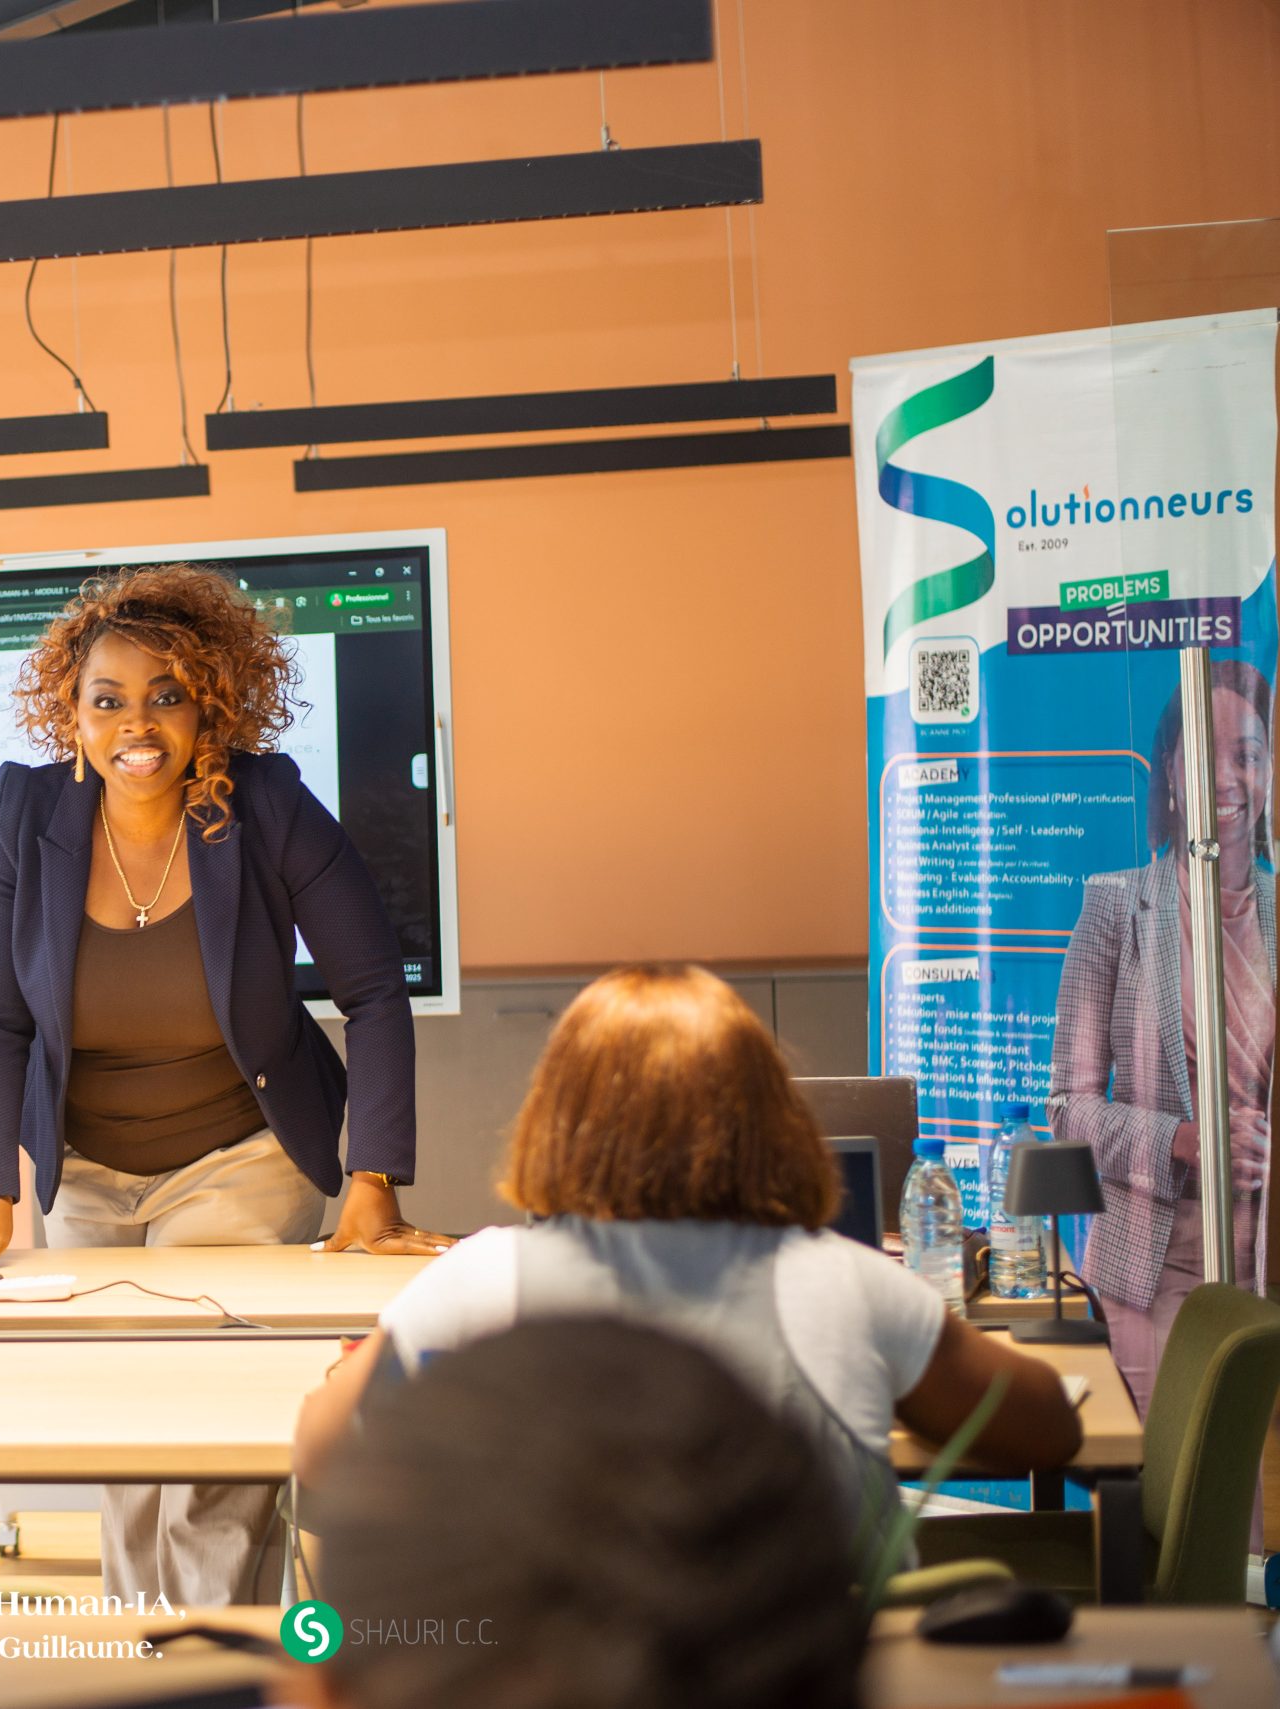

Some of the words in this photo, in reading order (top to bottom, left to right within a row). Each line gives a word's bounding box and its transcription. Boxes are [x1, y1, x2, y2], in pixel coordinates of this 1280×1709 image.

[1018, 540, 1038, 552] Est.
[1041, 538, 1069, 551] 2009
[1066, 577, 1160, 604] PROBLEMS
[1017, 616, 1232, 649] OPPORTUNITIES
[925, 793, 988, 806] Management
[989, 792, 1049, 804] Professional
[1051, 792, 1081, 805] (PMP)
[1083, 793, 1134, 803] certification
[933, 808, 958, 822] Agile
[1002, 824, 1022, 836] Self
[1031, 824, 1085, 838] Leadership
[932, 839, 969, 853] Analyst
[918, 856, 955, 869] Writing
[1002, 872, 1073, 887] Accountability
[932, 888, 969, 902] English
[936, 903, 992, 916] additionnels
[946, 1008, 970, 1019] mise
[1016, 1011, 1029, 1024] de
[921, 1023, 932, 1034] de
[934, 1024, 963, 1036] fonds
[971, 1040, 1029, 1056] indépendant
[931, 1054, 958, 1069] BMC,
[961, 1055, 1007, 1073] Scorecard,
[1009, 1058, 1056, 1073] Pitchdeck
[967, 1072, 974, 1083] &
[976, 1072, 1016, 1088] Influence
[929, 1085, 946, 1099] des
[949, 1087, 984, 1103] Risques
[993, 1091, 1005, 1102] du
